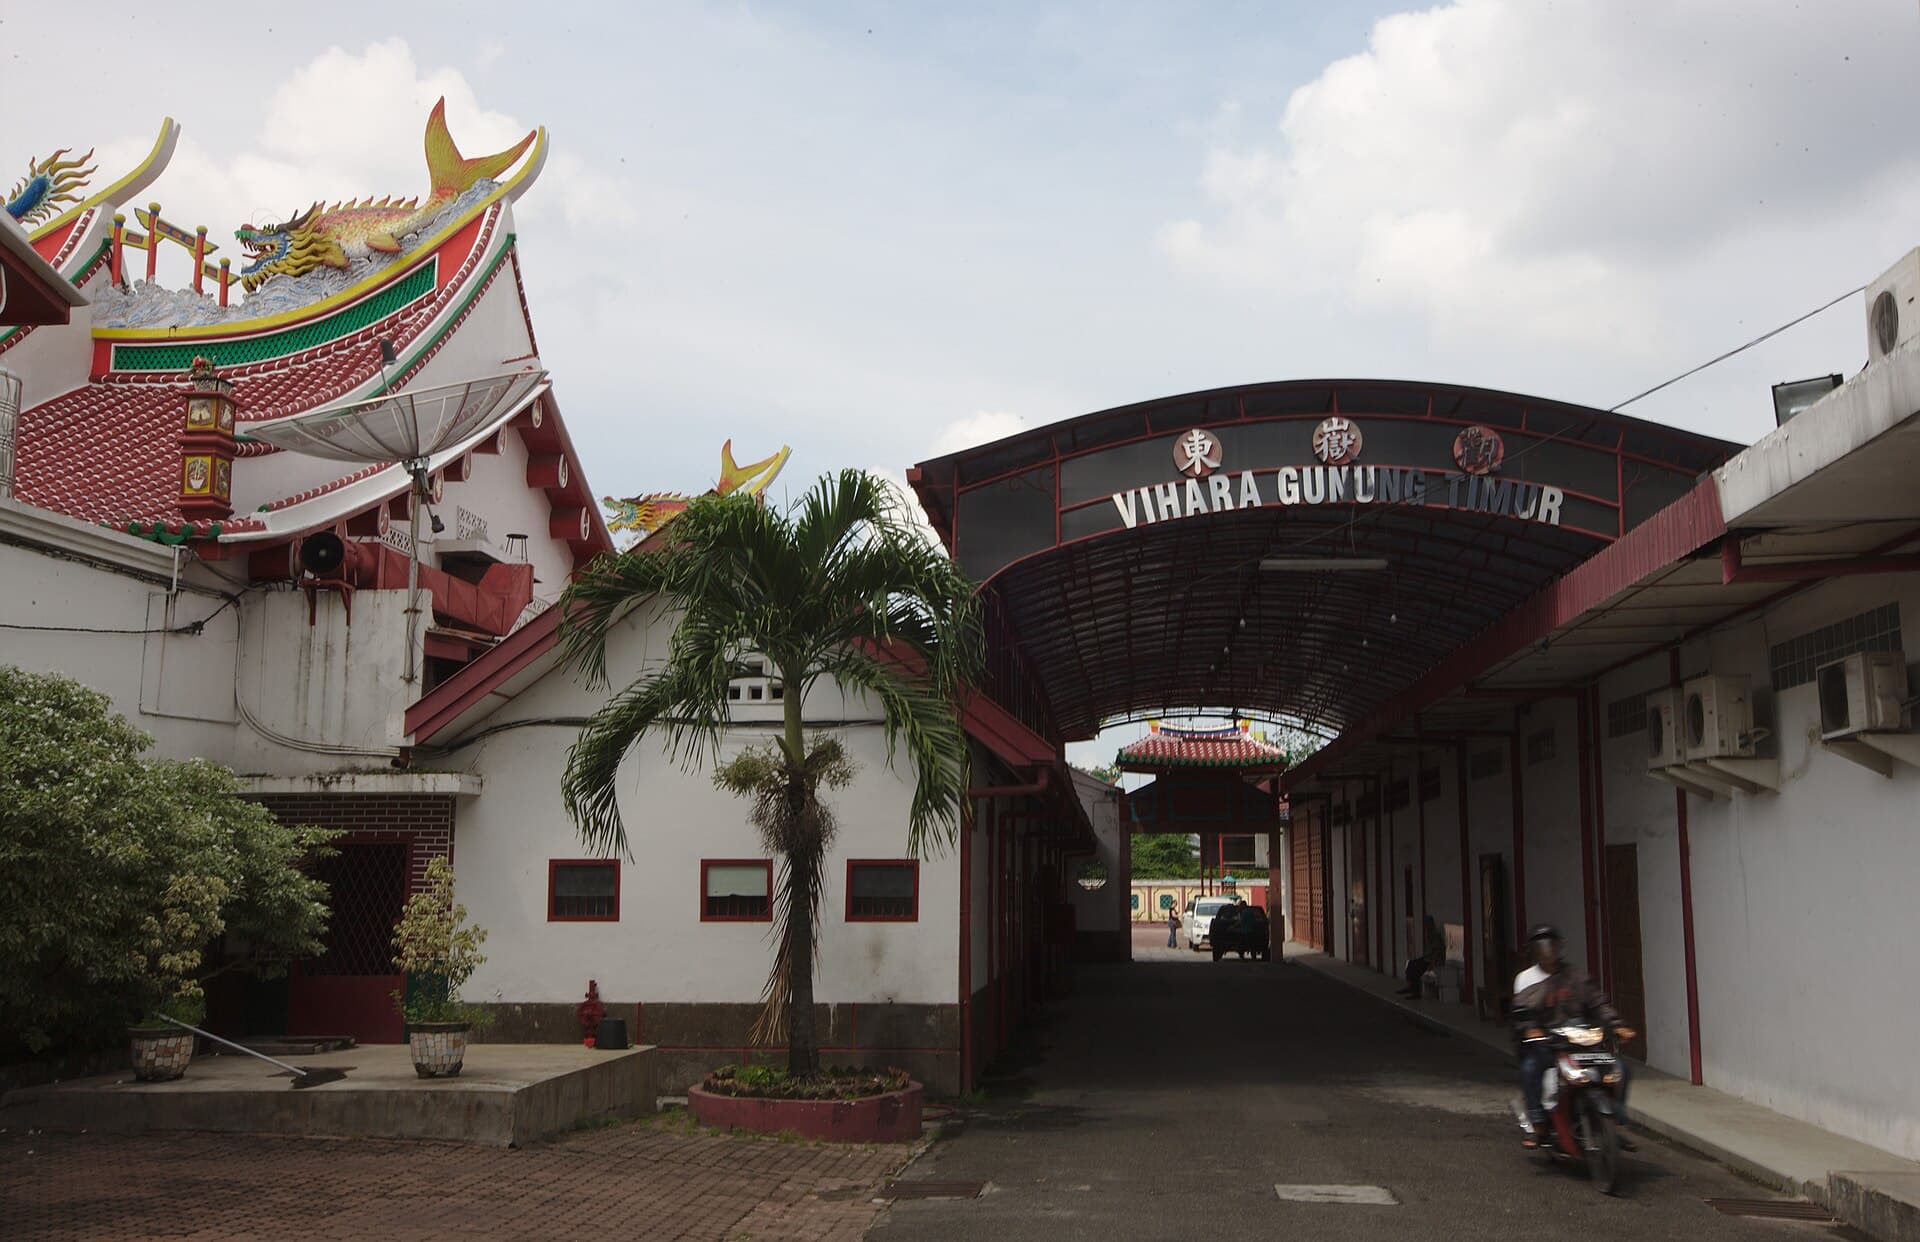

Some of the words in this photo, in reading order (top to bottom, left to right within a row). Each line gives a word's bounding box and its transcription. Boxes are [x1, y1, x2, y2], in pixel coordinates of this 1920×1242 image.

[1180, 429, 1221, 475] 東
[1112, 470, 1262, 529] VIHARA
[1277, 466, 1424, 505] GUNUNG
[1444, 472, 1563, 526] TIMUR
